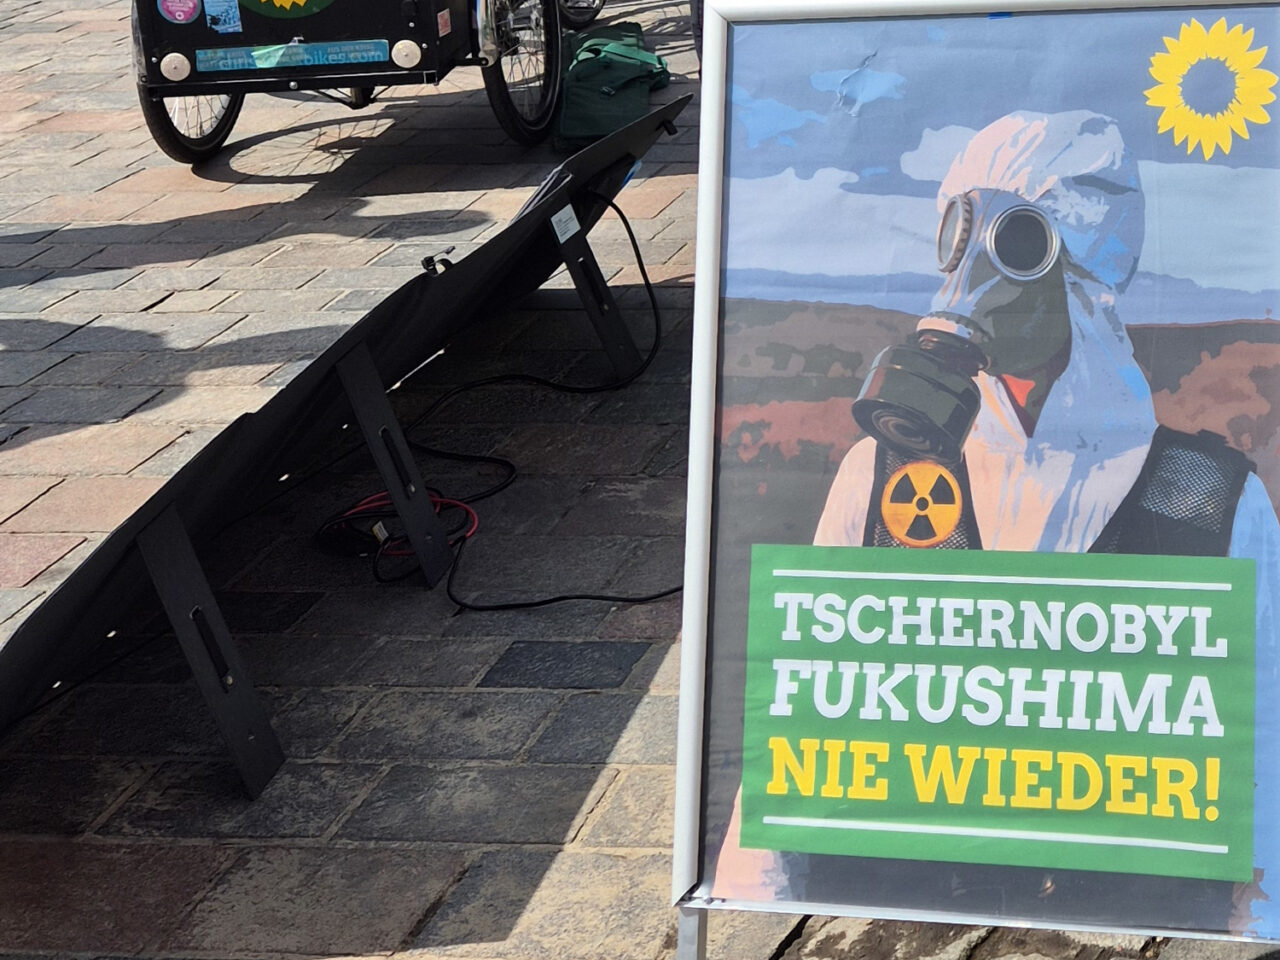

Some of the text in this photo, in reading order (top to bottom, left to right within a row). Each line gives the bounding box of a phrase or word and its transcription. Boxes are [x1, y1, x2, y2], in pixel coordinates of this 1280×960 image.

[773, 592, 1228, 658] TSCHERNOBYL
[768, 658, 1225, 737] FUKUSHIMA
[766, 736, 1222, 822] NIE WIEDER!
